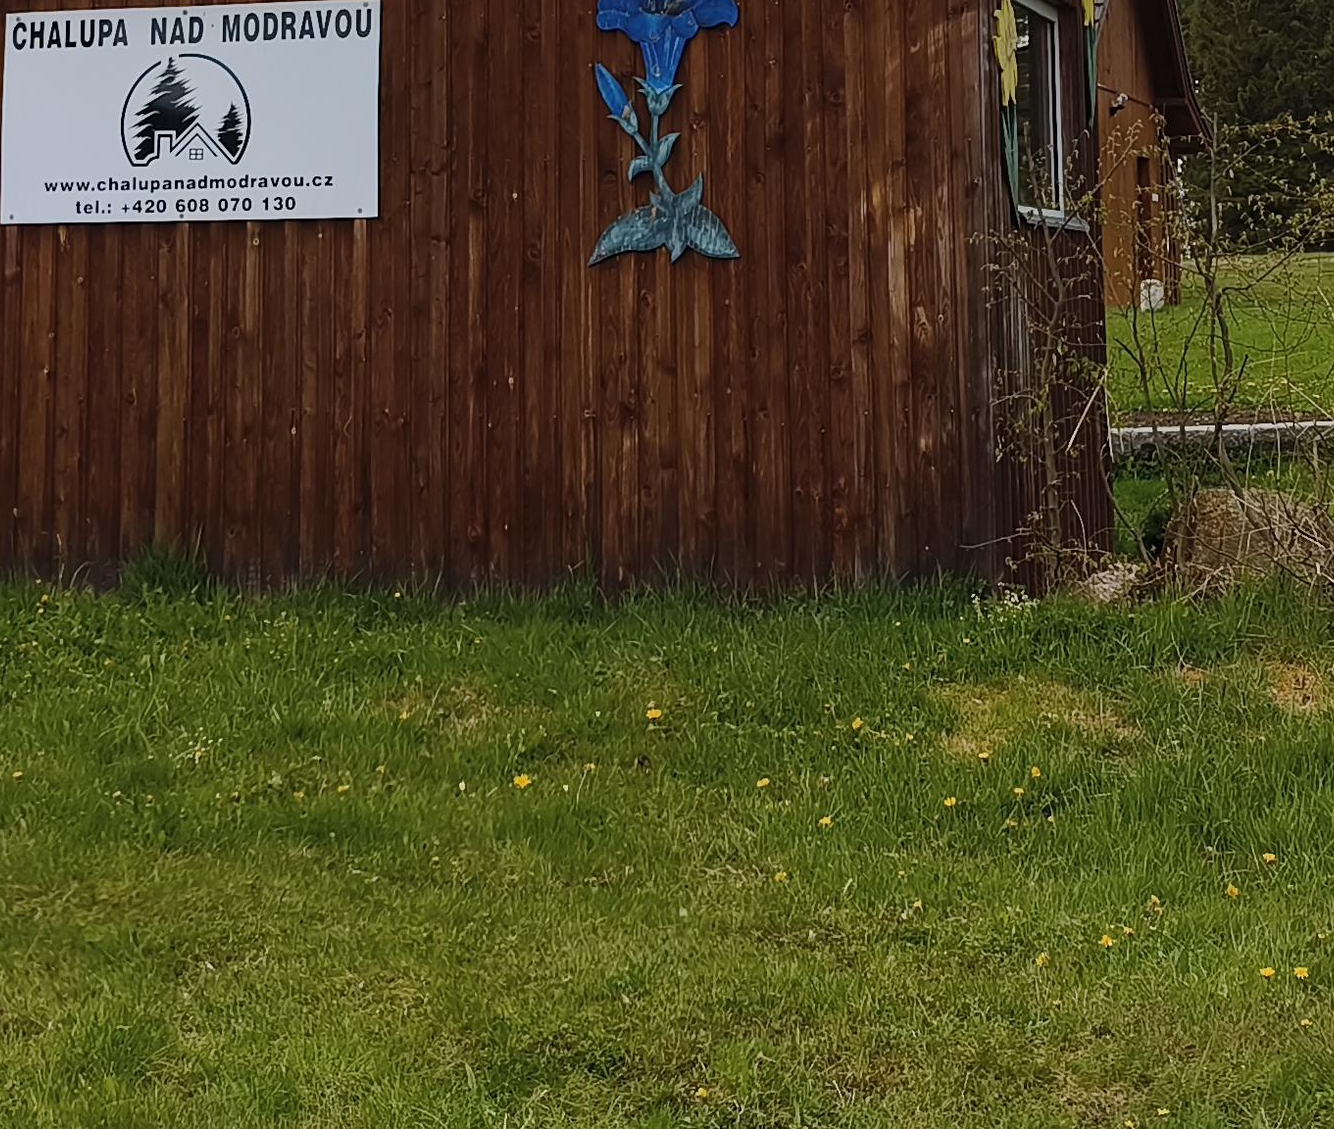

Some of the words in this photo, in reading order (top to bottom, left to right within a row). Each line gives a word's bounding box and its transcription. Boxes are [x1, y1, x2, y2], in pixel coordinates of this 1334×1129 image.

[12, 18, 128, 50] CHALUPA
[150, 16, 204, 45] NAD
[222, 8, 372, 43] MODRAVOU
[44, 174, 333, 193] www.chalupanadmodravou.cz
[75, 200, 112, 214] tel.:
[121, 199, 167, 214] +420
[175, 198, 209, 213] 608
[218, 197, 252, 212] 070
[262, 196, 296, 211] 130
